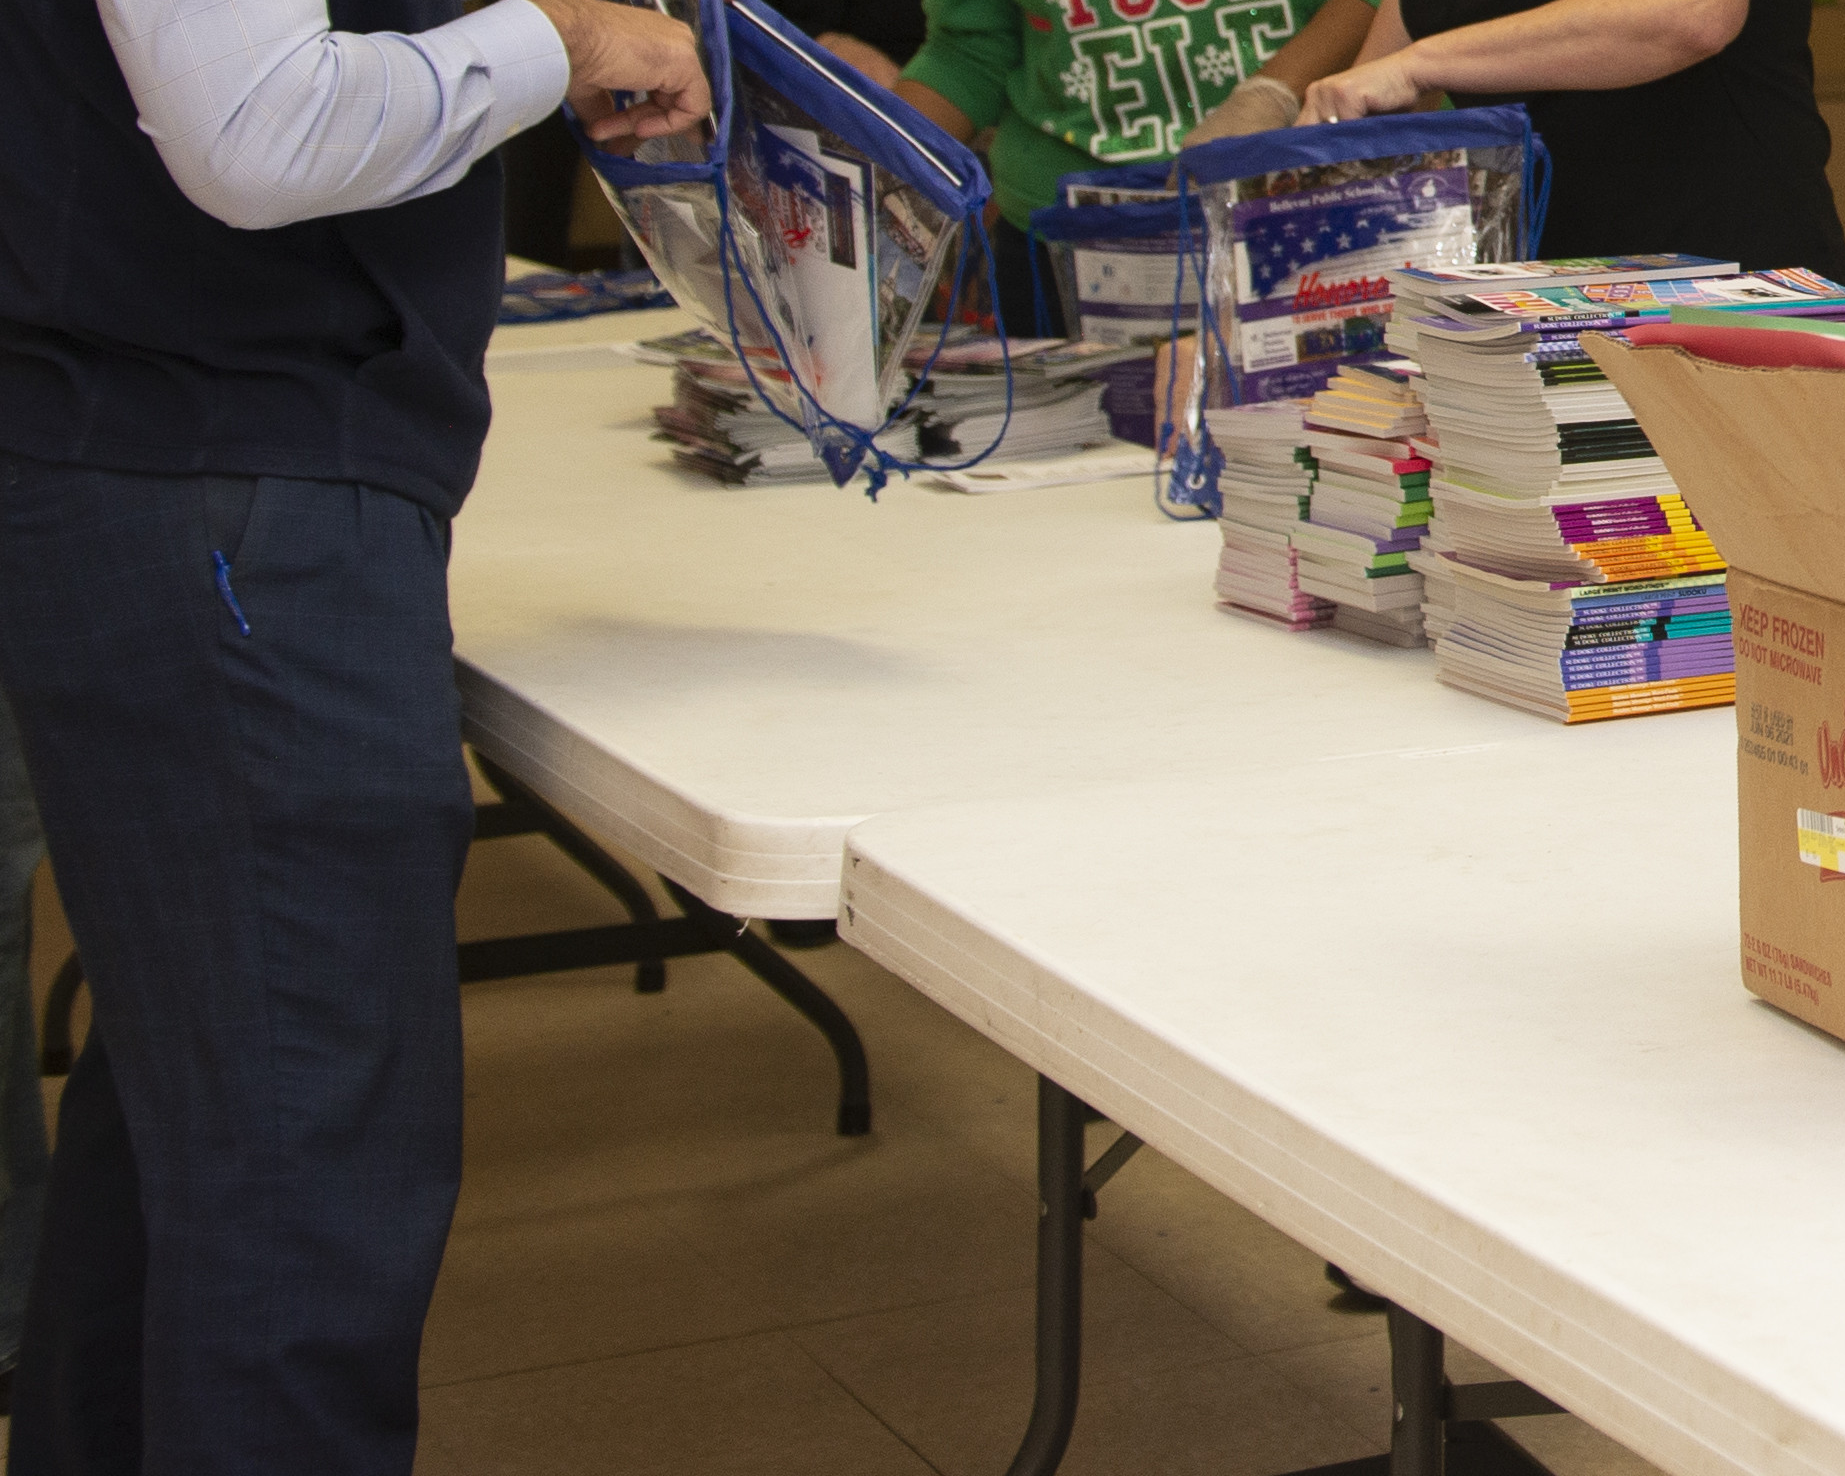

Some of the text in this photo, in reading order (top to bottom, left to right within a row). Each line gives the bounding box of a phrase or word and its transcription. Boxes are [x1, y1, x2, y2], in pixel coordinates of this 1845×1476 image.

[1312, 193, 1342, 205] Public
[1678, 589, 1707, 597] SUDOKU
[1739, 603, 1824, 659] KEEP FROZEN
[1739, 637, 1822, 685] DO NOT MICROWAVE
